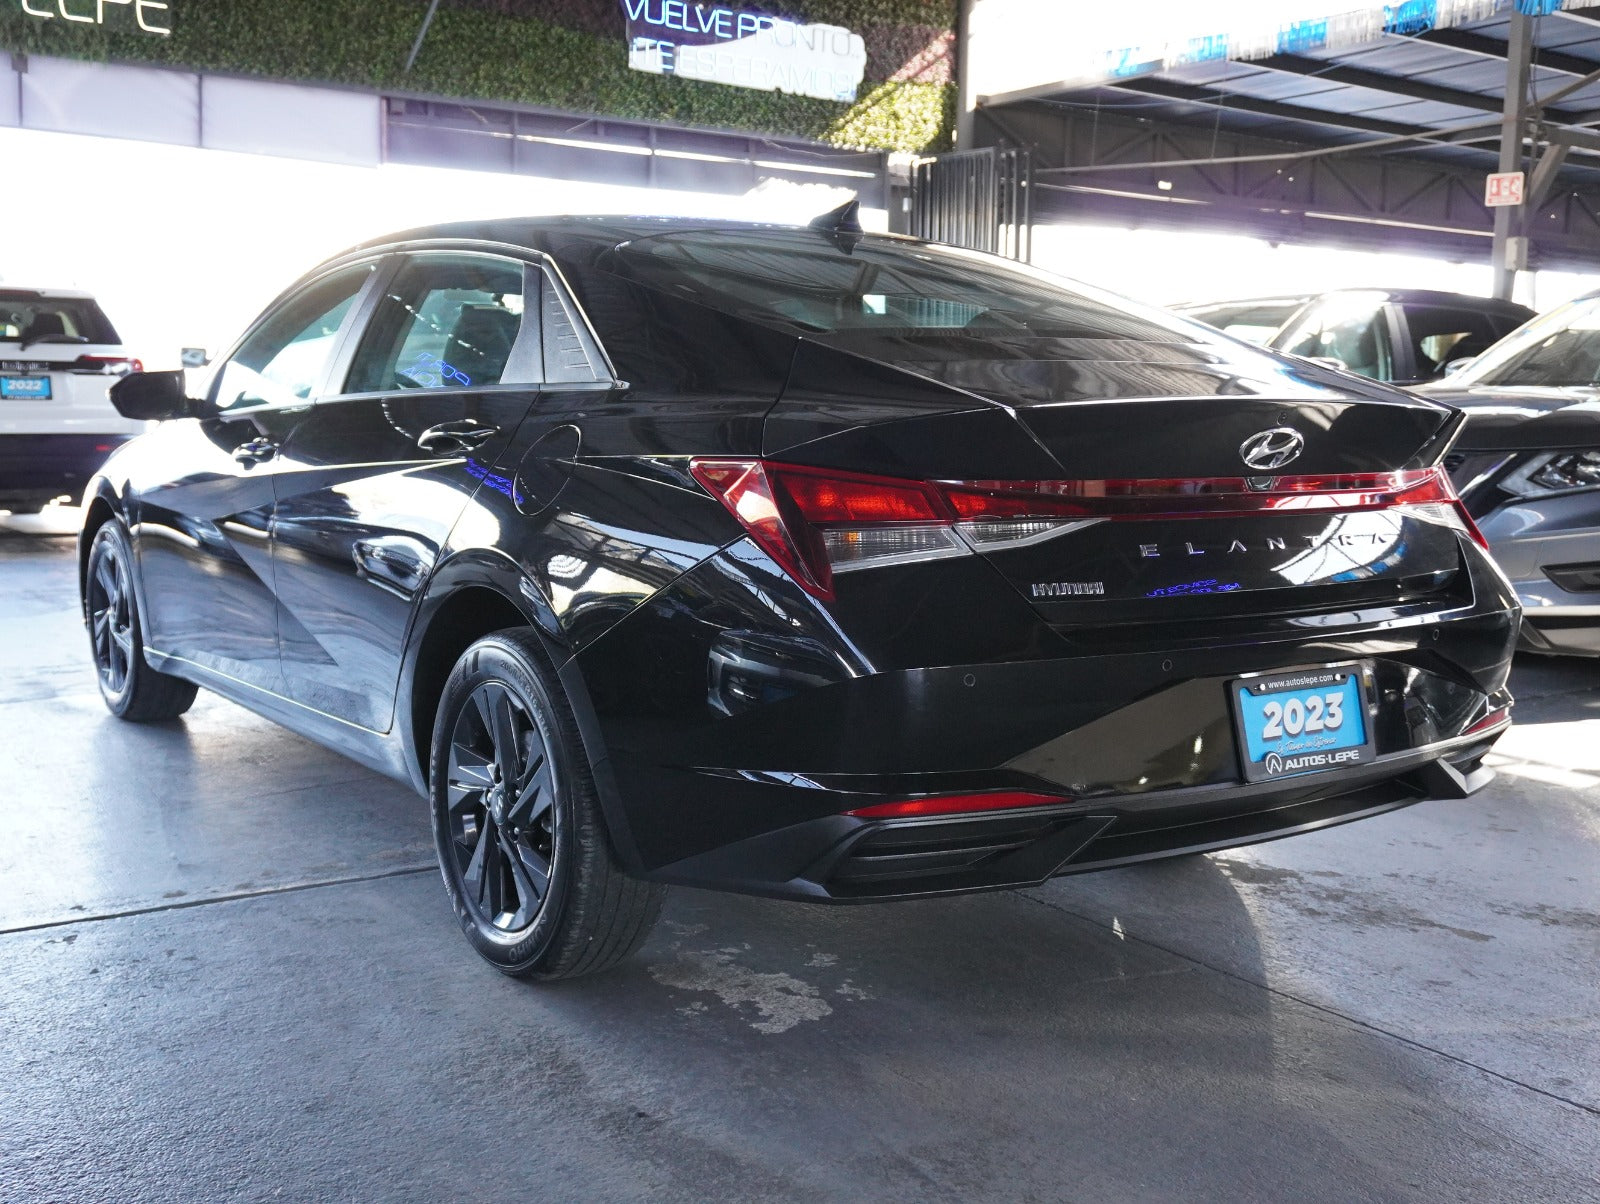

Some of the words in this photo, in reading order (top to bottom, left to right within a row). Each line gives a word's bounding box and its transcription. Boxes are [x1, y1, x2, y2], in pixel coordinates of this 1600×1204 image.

[624, 0, 733, 39] VUELVE
[1139, 533, 1387, 558] ELANTRA
[1031, 582, 1105, 597] HYUNDAI
[1267, 673, 1334, 689] www.autoslepe.com
[1263, 692, 1344, 739] 2023
